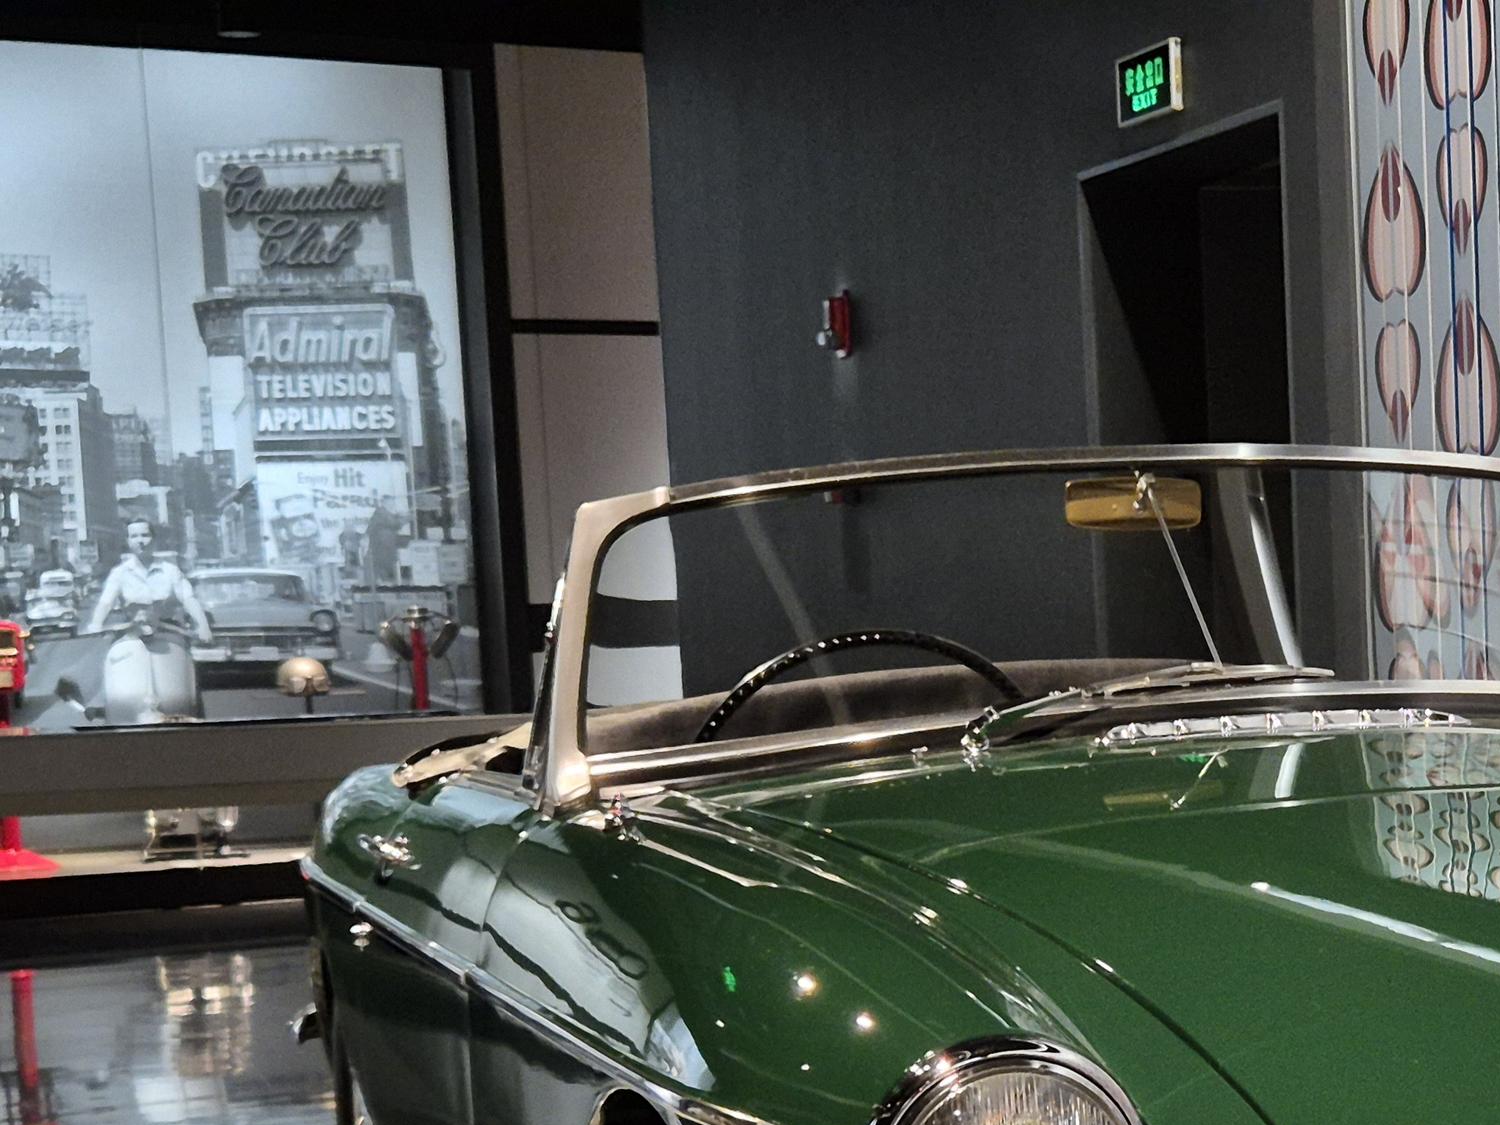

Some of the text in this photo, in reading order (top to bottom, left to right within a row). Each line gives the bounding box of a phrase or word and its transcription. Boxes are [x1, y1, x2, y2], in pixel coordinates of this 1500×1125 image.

[1132, 87, 1158, 112] EXIT
[221, 163, 387, 217] Canadian
[257, 216, 361, 267] Club
[251, 315, 393, 364] Admiral
[256, 371, 392, 399] TELEVISION
[258, 404, 396, 432] APPLIANCES
[334, 467, 366, 488] Hit
